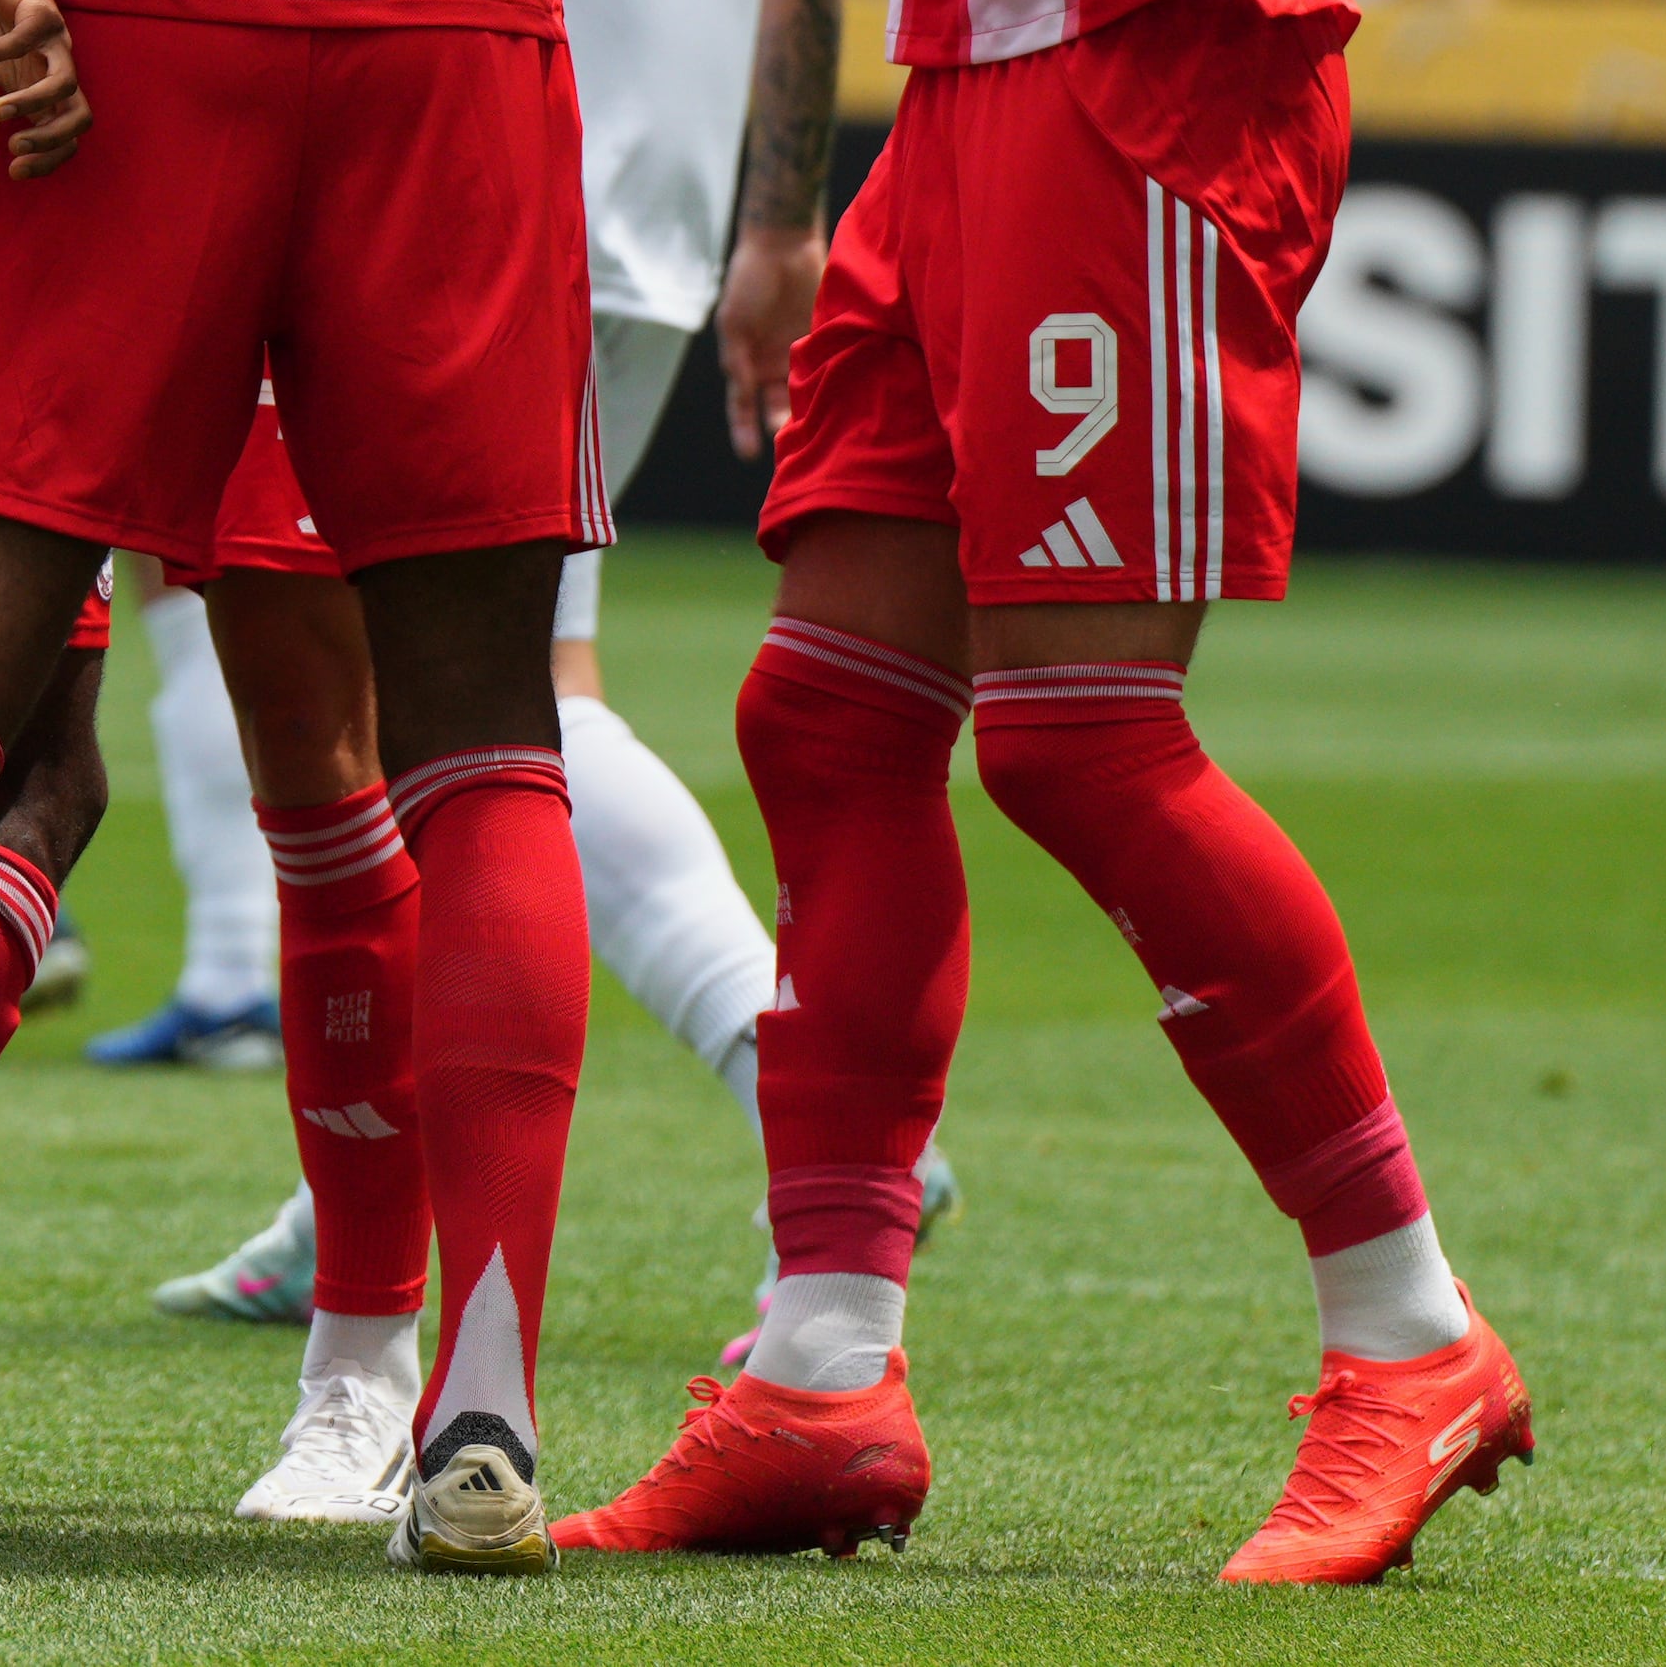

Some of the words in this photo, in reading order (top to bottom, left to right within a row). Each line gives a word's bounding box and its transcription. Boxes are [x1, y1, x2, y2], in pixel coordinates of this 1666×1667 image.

[1028, 312, 1118, 477] 9
[327, 990, 371, 1011] MIA
[325, 1024, 370, 1043] MIA
